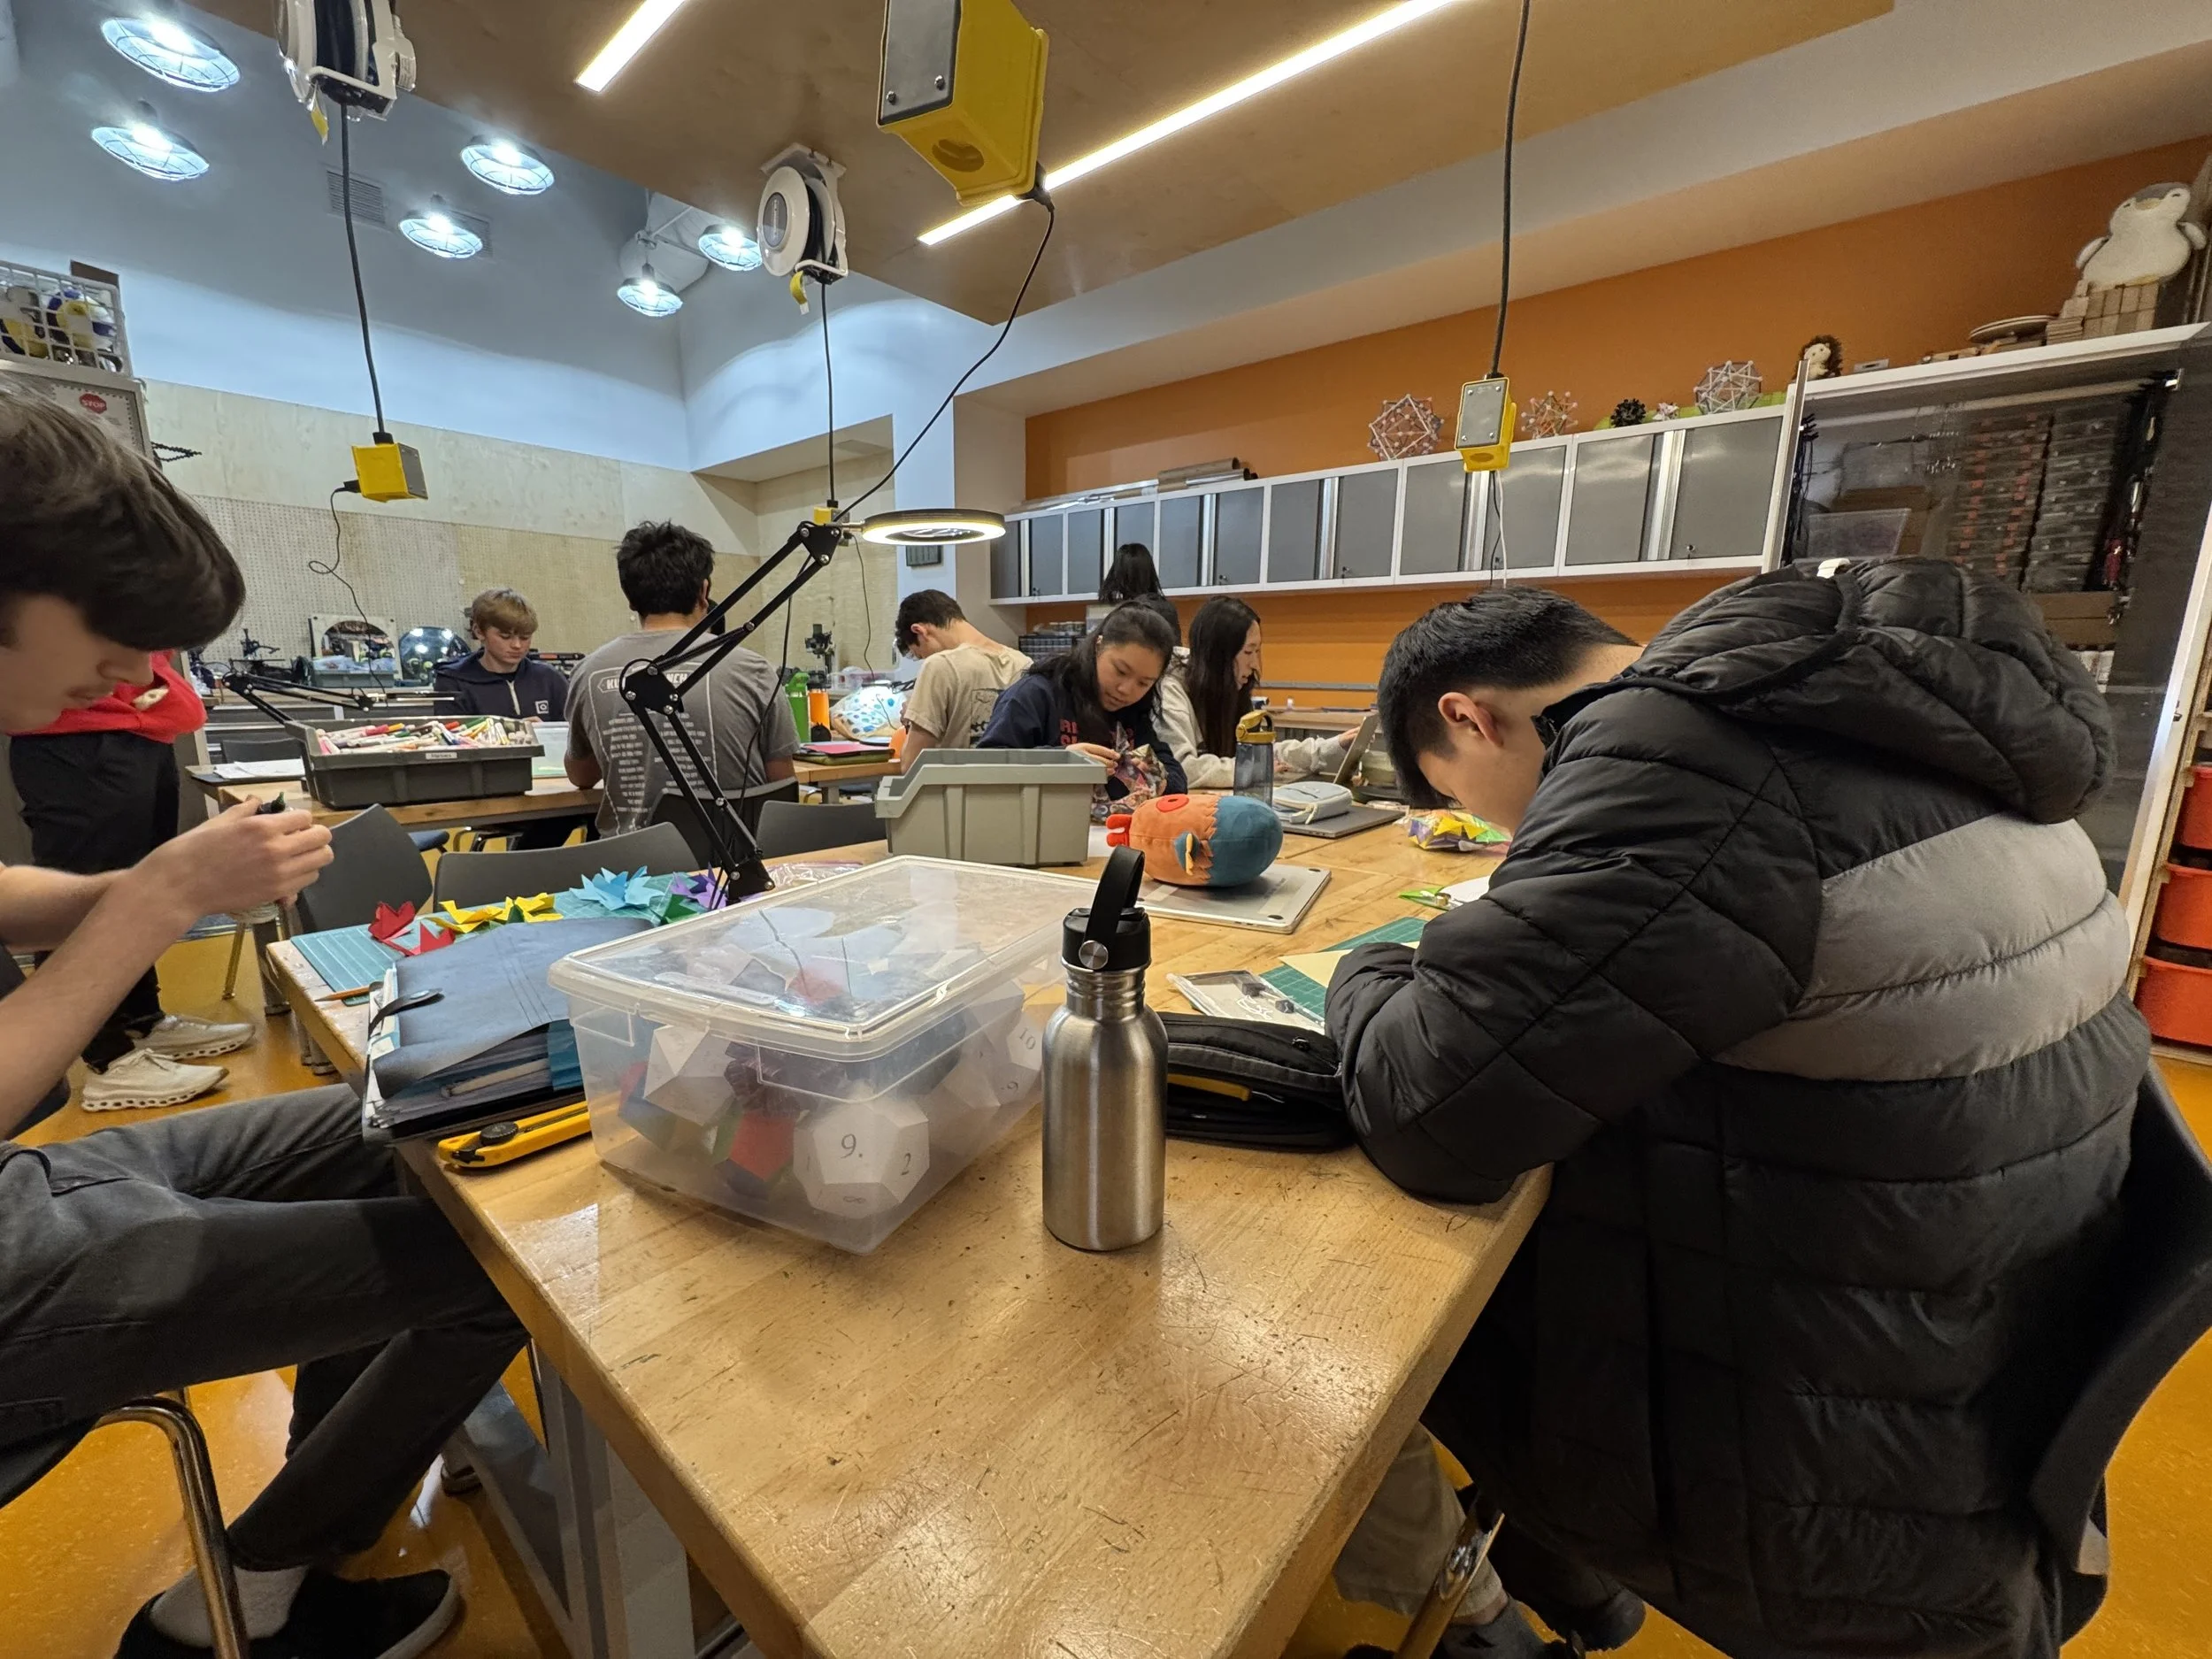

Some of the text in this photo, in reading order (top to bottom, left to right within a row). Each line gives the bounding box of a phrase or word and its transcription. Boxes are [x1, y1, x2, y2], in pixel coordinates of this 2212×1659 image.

[81, 399, 105, 408] STOP
[1019, 1028, 1037, 1050] 10
[901, 1152, 911, 1176] 2
